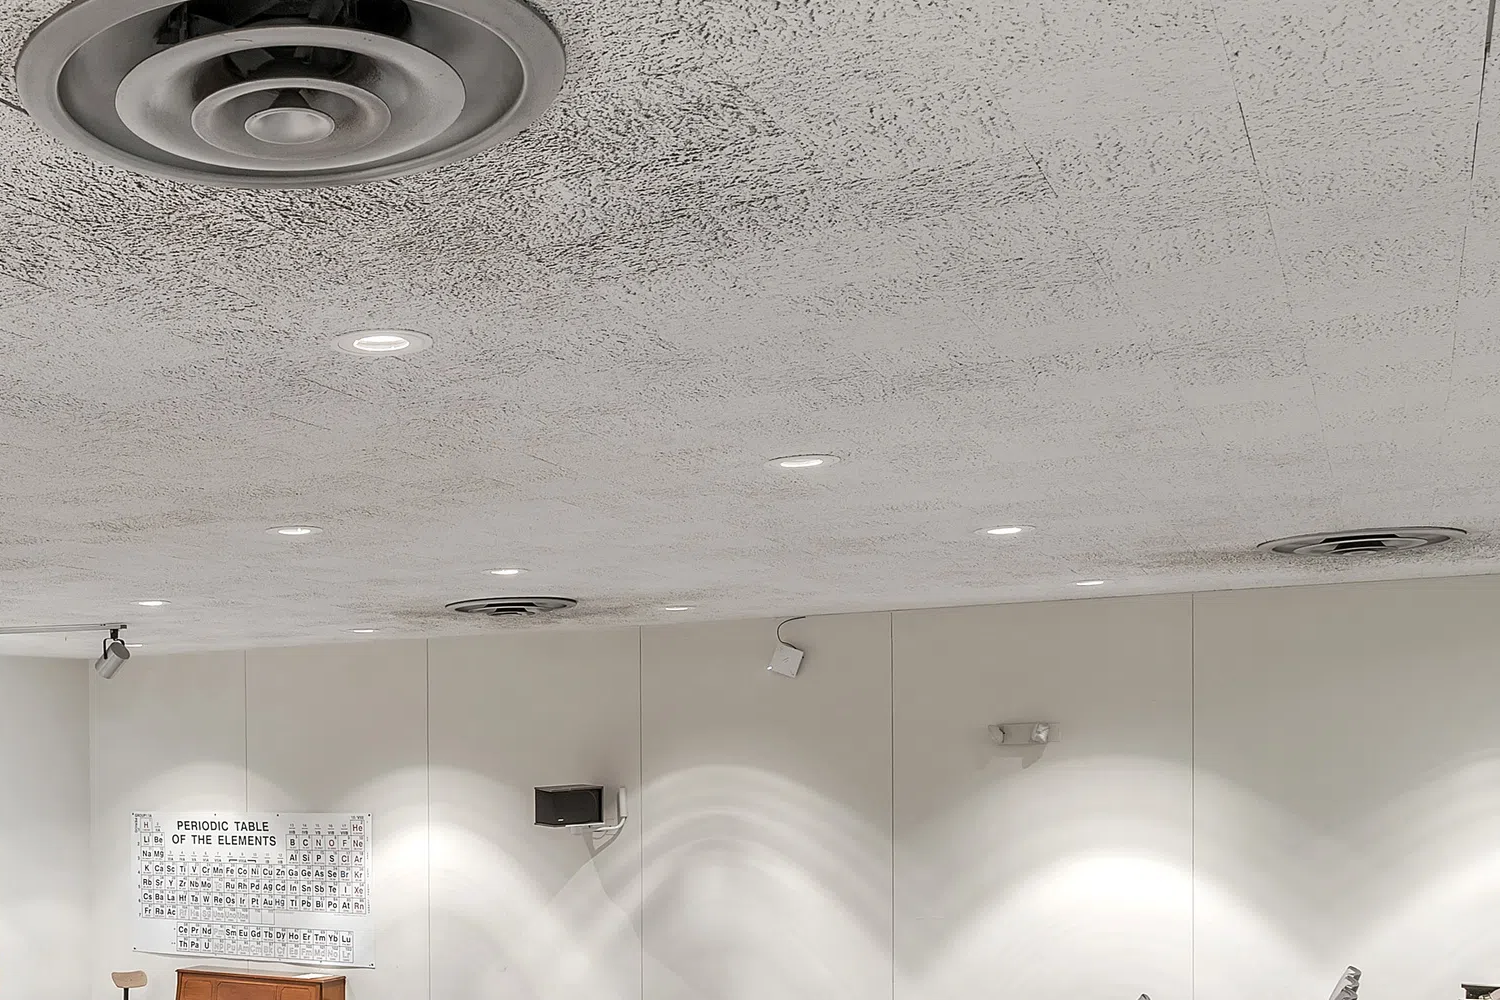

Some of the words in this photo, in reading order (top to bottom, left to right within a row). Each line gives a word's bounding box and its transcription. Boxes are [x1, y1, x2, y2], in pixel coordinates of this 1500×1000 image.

[143, 821, 149, 829] H
[177, 820, 229, 831] PERIODIC
[234, 821, 269, 831] TABLE
[352, 824, 363, 832] He
[143, 835, 150, 843] Li
[153, 835, 163, 844] Be
[171, 834, 186, 845] OF
[191, 834, 212, 845] THE
[218, 835, 277, 846] ELEMENTS
[290, 838, 296, 846] B
[302, 839, 309, 847] C
[315, 839, 322, 847] N
[328, 839, 335, 847] O
[153, 850, 164, 859] Mg
[302, 854, 310, 862] Si
[329, 854, 335, 863] S
[341, 855, 350, 863] Cl
[354, 855, 363, 863] Ar
[166, 865, 176, 873] Sc
[201, 866, 210, 874] Cr
[225, 867, 235, 875] Fe
[237, 867, 248, 875] Co
[262, 868, 273, 876] Cu
[275, 868, 286, 876] Zn
[288, 869, 299, 877] Ga
[301, 869, 312, 877] Ge
[327, 870, 337, 878] Se
[340, 870, 349, 878] Br
[354, 871, 363, 879] Kr
[142, 878, 152, 886] Rb
[189, 880, 199, 888] Nb
[201, 881, 212, 889] Mo
[225, 881, 235, 889] Ru
[237, 882, 248, 890] Rh
[250, 882, 260, 890] Pd
[262, 883, 273, 892] Ag
[275, 883, 286, 891] Cd
[289, 884, 297, 892] In
[314, 885, 325, 893] Sb
[328, 885, 337, 893] Te
[344, 886, 347, 894] I
[354, 886, 363, 894] Xe
[178, 894, 187, 902] Hf
[213, 896, 223, 904] Re
[225, 896, 236, 904] Os
[239, 897, 245, 905] Ir
[251, 897, 259, 905] Pt
[262, 898, 273, 906] Au
[274, 898, 285, 907] Hg
[290, 899, 297, 907] Tl
[301, 900, 312, 908] Pb
[341, 901, 350, 909] At
[354, 902, 365, 910] Rn
[155, 907, 164, 915] Ra
[166, 908, 176, 916] Ac
[178, 925, 188, 934] Ce
[191, 926, 199, 934] Pr
[202, 927, 212, 935] Nd
[225, 928, 237, 936] Sm
[238, 929, 248, 937] Eu
[250, 930, 261, 938] Gd
[263, 930, 273, 939] Tb
[276, 931, 286, 940] Dy
[328, 934, 338, 942] Yb
[342, 935, 351, 943] Lu
[179, 940, 188, 948] Th
